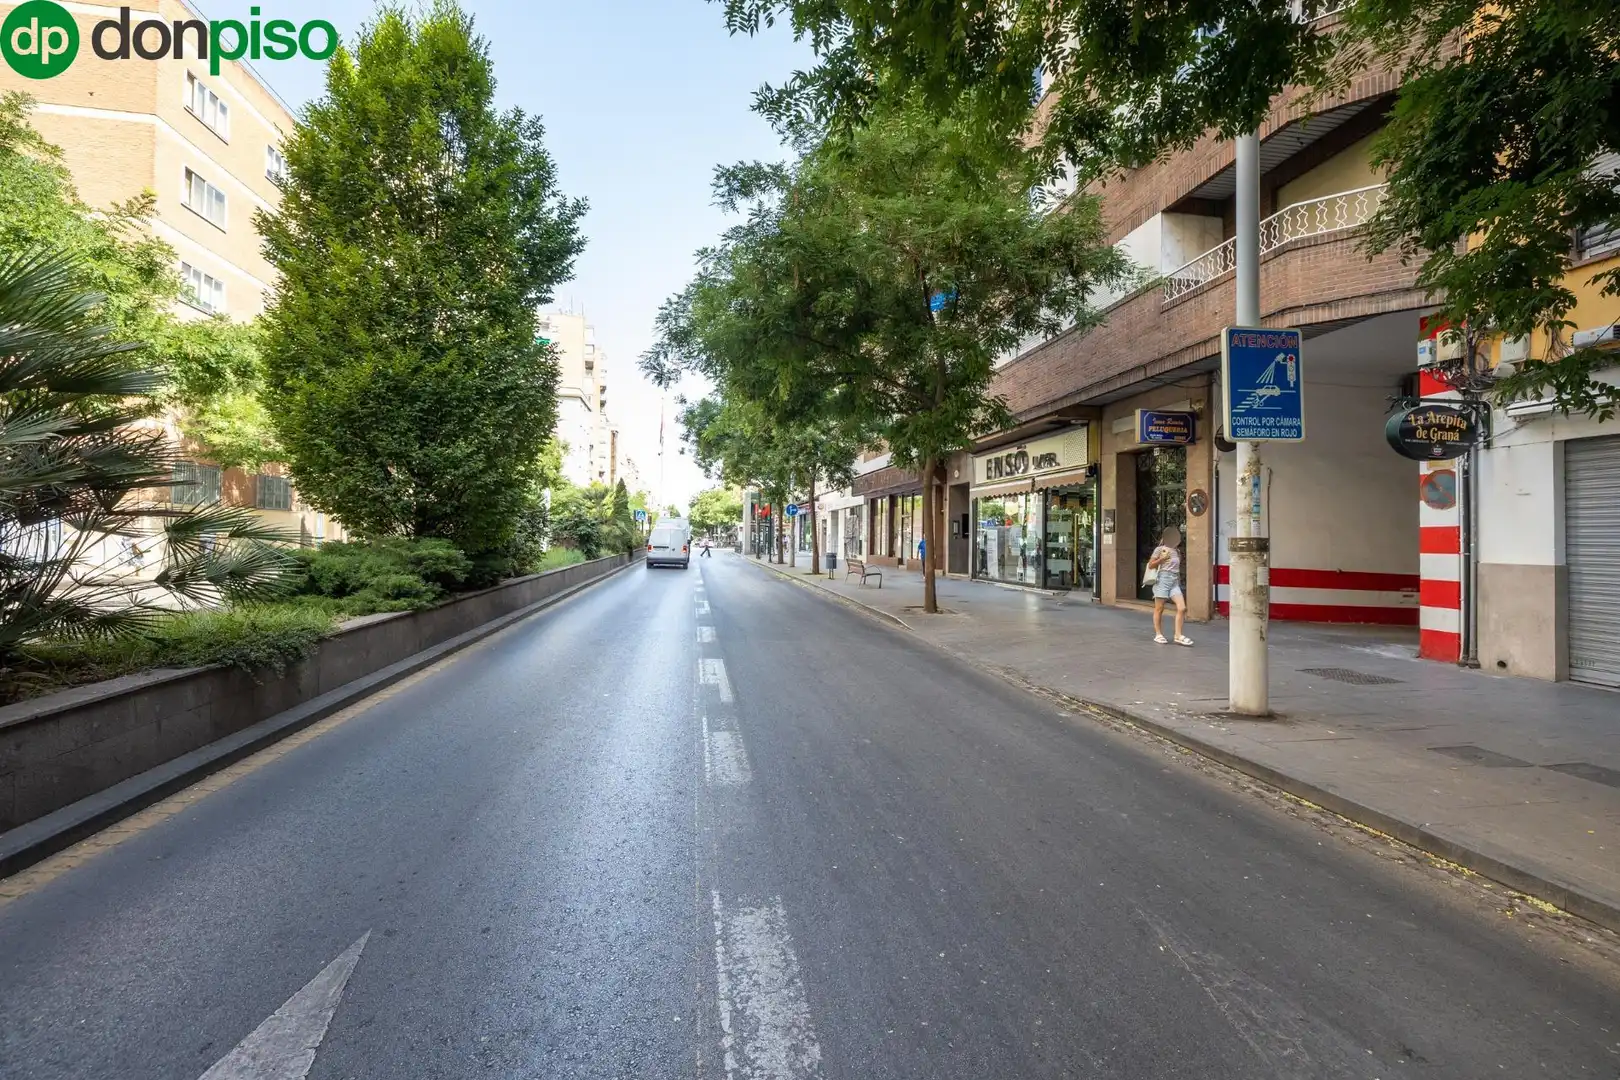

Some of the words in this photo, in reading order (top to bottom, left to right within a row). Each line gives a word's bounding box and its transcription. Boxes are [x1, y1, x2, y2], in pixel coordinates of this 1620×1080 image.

[1231, 333, 1298, 348] ATENCIÓN
[1232, 416, 1261, 426] CONTROL
[1262, 417, 1275, 426] POR
[1276, 415, 1301, 426] CÁMARA
[1408, 414, 1424, 426] La
[1427, 411, 1467, 430] Arepita
[1236, 426, 1271, 437] SEMÁFORO
[1271, 428, 1280, 437] EN
[1281, 428, 1298, 437] ROJO
[1416, 426, 1428, 439] de
